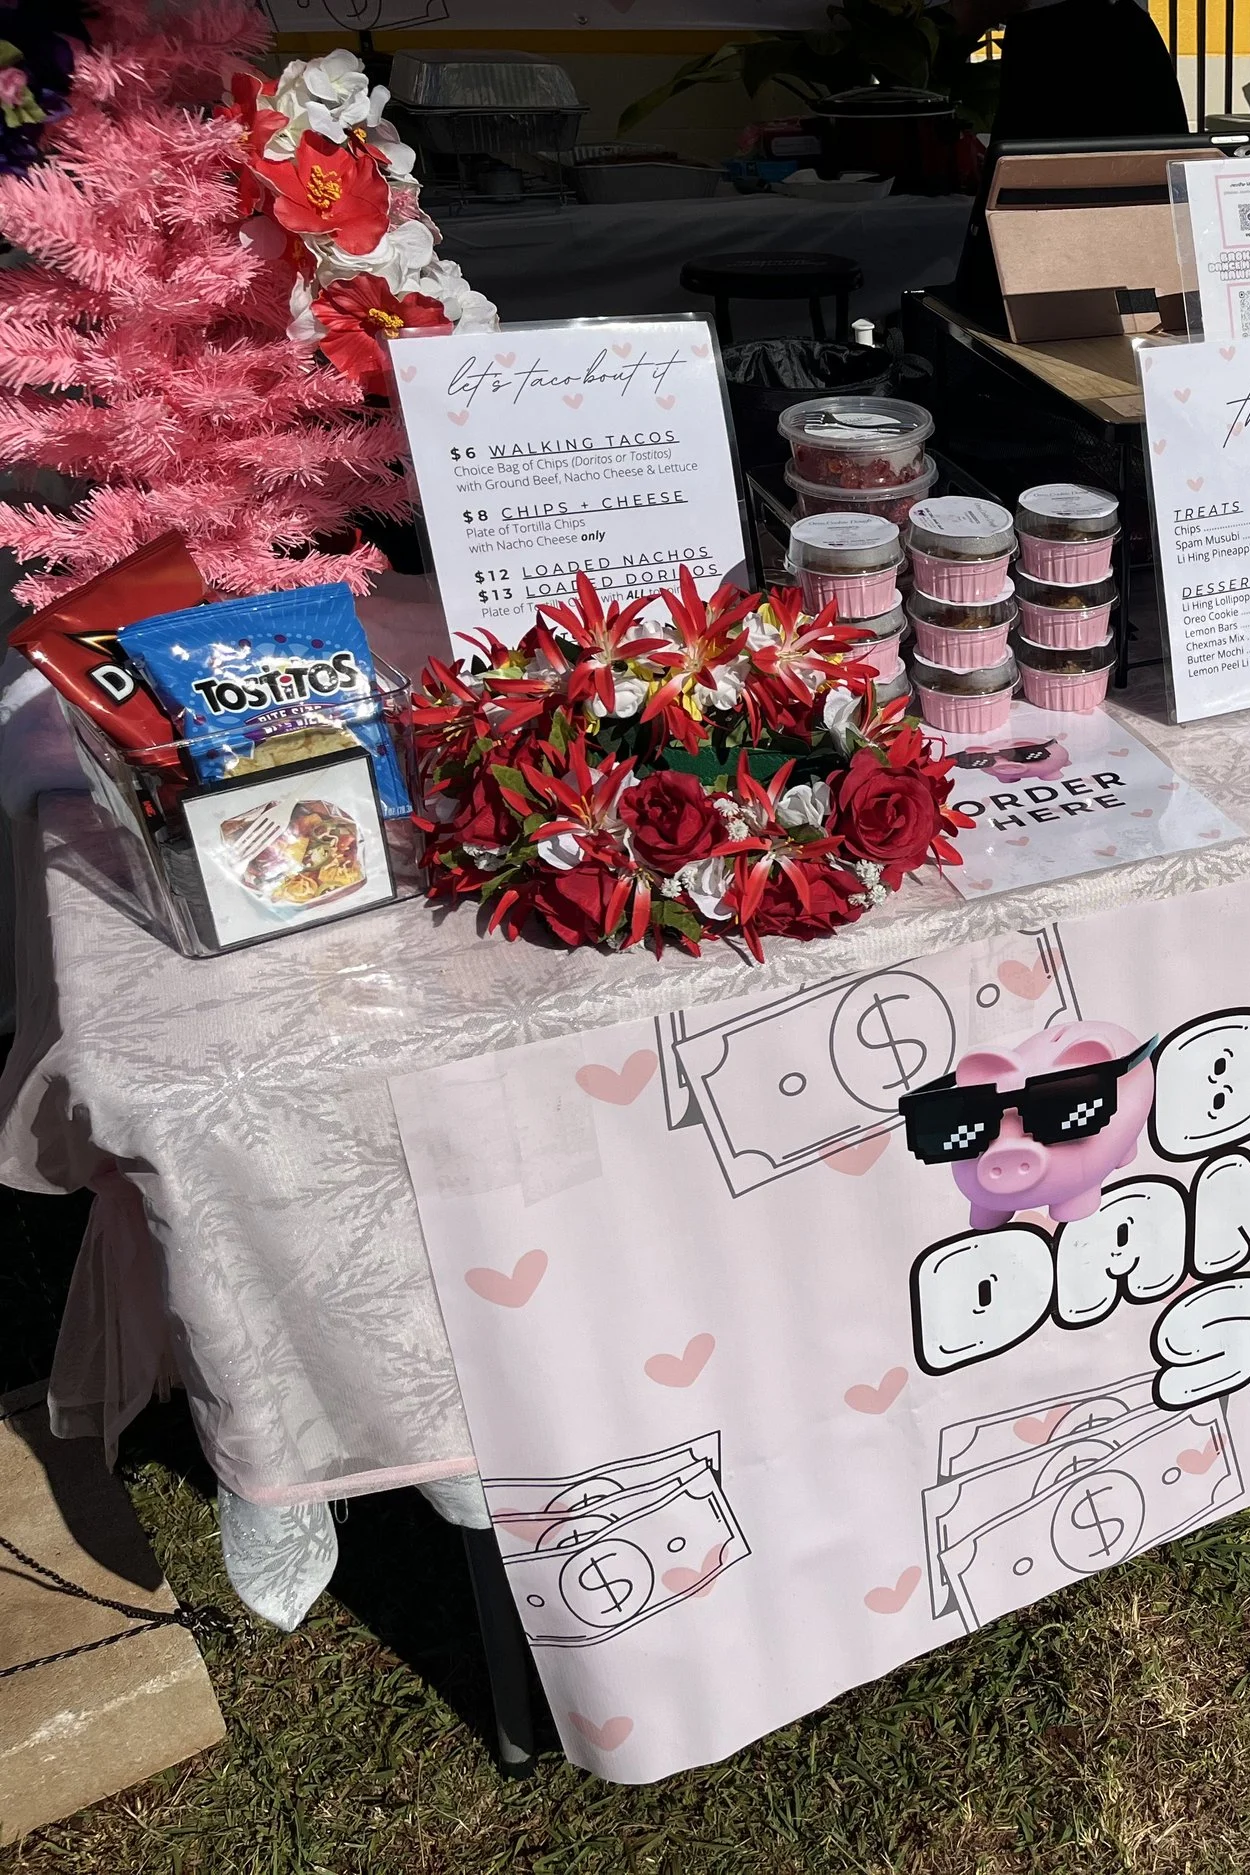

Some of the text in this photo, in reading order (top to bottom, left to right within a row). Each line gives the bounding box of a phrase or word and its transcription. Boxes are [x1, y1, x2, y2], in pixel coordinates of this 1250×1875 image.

[1208, 260, 1241, 273] DANCE
[447, 355, 511, 408] let's
[652, 349, 687, 394] it
[489, 437, 594, 457] WALKING
[605, 430, 676, 446] TACOS
[454, 448, 672, 478] Choice Bag of Chips (Doritos or Tostitos)
[457, 460, 698, 493] with Ground Beef, Nacho Cheese & Lettuce
[501, 501, 569, 520] CHIPS
[581, 501, 589, 510] +
[602, 490, 685, 510] CHEESE
[1174, 501, 1241, 521] TREATS
[466, 515, 585, 539] Plate of Tortilla Chips
[1174, 524, 1201, 537] Chips
[469, 529, 606, 554] with Nacho Cheese only
[1175, 538, 1203, 552] Spam
[1205, 532, 1241, 546] Musubi
[474, 546, 709, 585] $12 LOADED NACHOS
[1177, 554, 1185, 564] Li
[1187, 551, 1211, 564] Hing
[478, 588, 513, 604] $13
[627, 563, 719, 585] DORIOS
[482, 605, 510, 618] Plate
[513, 602, 525, 615] of
[601, 590, 624, 603] with
[626, 588, 645, 602] ALL
[1182, 601, 1190, 612] Li
[1192, 599, 1213, 613] Hing
[1215, 593, 1250, 609] Lollipop
[1184, 614, 1206, 626] Oreo
[1208, 607, 1239, 622] Cookie
[1185, 625, 1215, 639] Lemon
[1218, 621, 1238, 634] Bars
[1186, 636, 1227, 652] Chexmas
[1229, 633, 1245, 644] Mix
[1187, 651, 1215, 666] Butter
[1217, 647, 1244, 660] Mochi
[1188, 664, 1219, 678] Lemon
[1221, 660, 1239, 674] Peel
[1242, 658, 1250, 668] Li
[952, 772, 1127, 817] ORDER
[993, 794, 1127, 831] HERE
